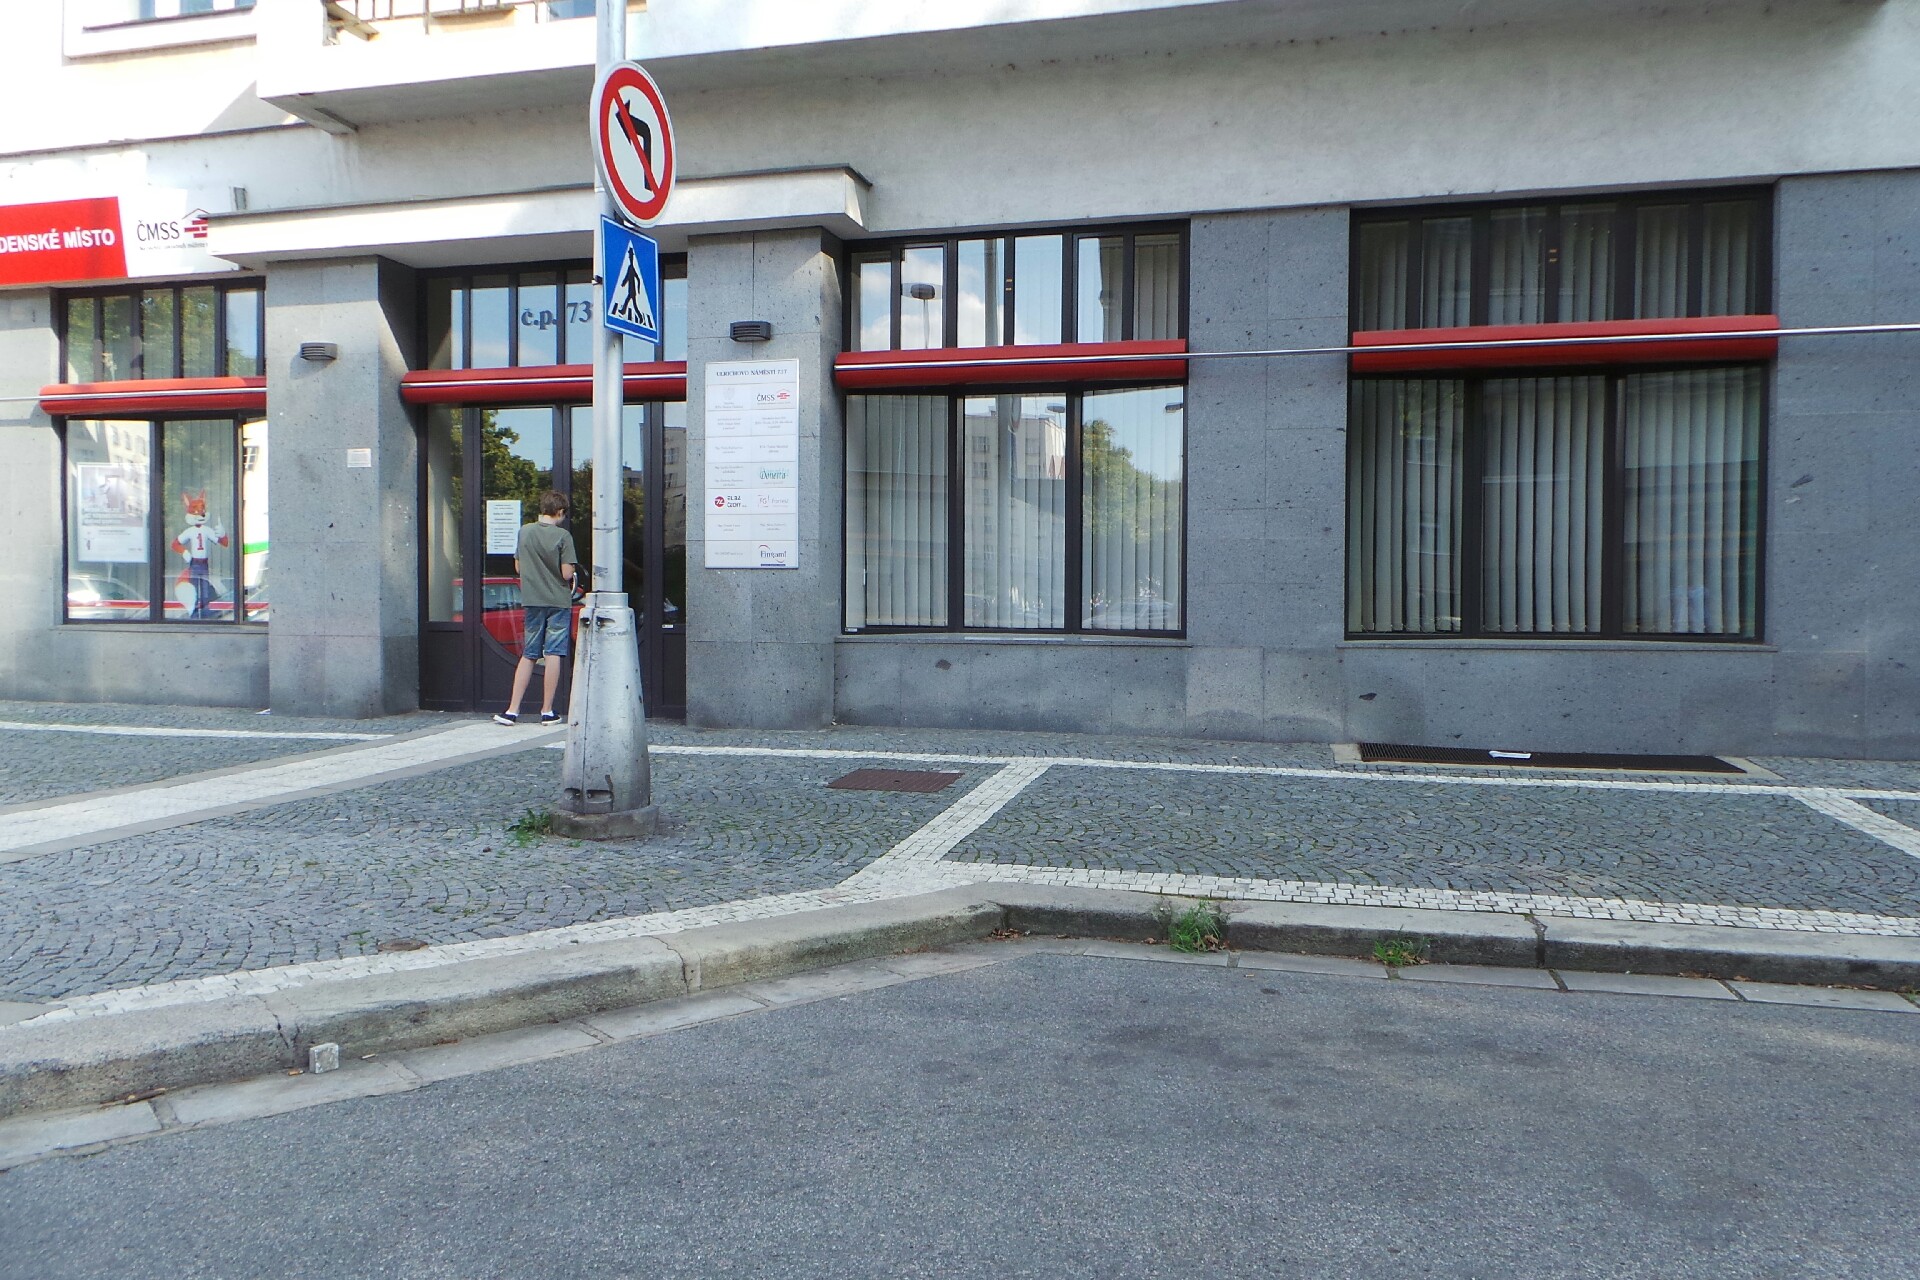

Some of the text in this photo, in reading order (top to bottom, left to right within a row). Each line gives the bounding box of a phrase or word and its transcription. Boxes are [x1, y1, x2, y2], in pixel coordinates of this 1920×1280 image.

[63, 226, 116, 249] MÍSTO
[137, 219, 180, 241] ČMSS
[567, 300, 594, 325] 73
[756, 393, 775, 402] ČMSS
[196, 533, 204, 550] 1
